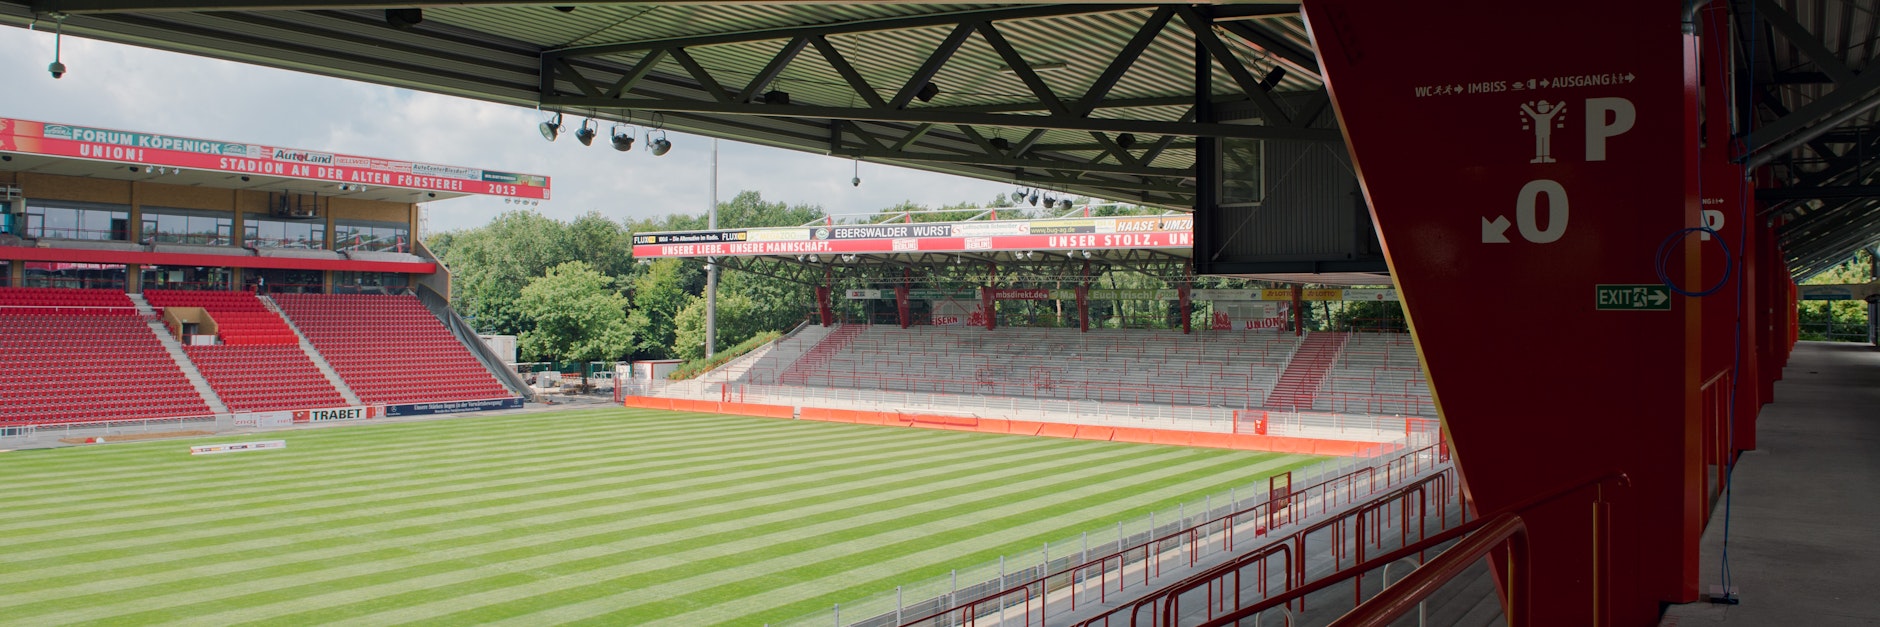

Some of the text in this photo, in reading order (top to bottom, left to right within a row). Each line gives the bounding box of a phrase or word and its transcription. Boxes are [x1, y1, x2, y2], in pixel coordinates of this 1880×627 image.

[1415, 73, 1610, 98] WC IMBISS AUSGANG
[1585, 97, 1637, 161] P
[72, 128, 222, 155] FORUM KÖPENICK
[80, 143, 144, 161] UNION!
[275, 149, 333, 164] AutoLand
[220, 157, 463, 190] STADION AN DER ALTEN FÖRSTEREI
[488, 183, 517, 195] 2013
[834, 227, 908, 238] EBERSWALDER
[913, 226, 951, 237] WURST
[1030, 225, 1075, 234] www.bug-ag.de
[1117, 220, 1155, 231] HAASE
[1701, 210, 1725, 241] P
[1049, 233, 1193, 247] UNSER STOLZ. UN
[661, 241, 832, 255] UNSERE LIEBE. UNSERE MANNSCHAFT.
[995, 291, 1043, 299] mbsdirekt.de
[1093, 291, 1118, 299] Euch
[1120, 290, 1153, 299] frisch!
[1599, 289, 1633, 305] EXIT
[1245, 317, 1279, 330] UNION
[312, 408, 363, 421] TRABET
